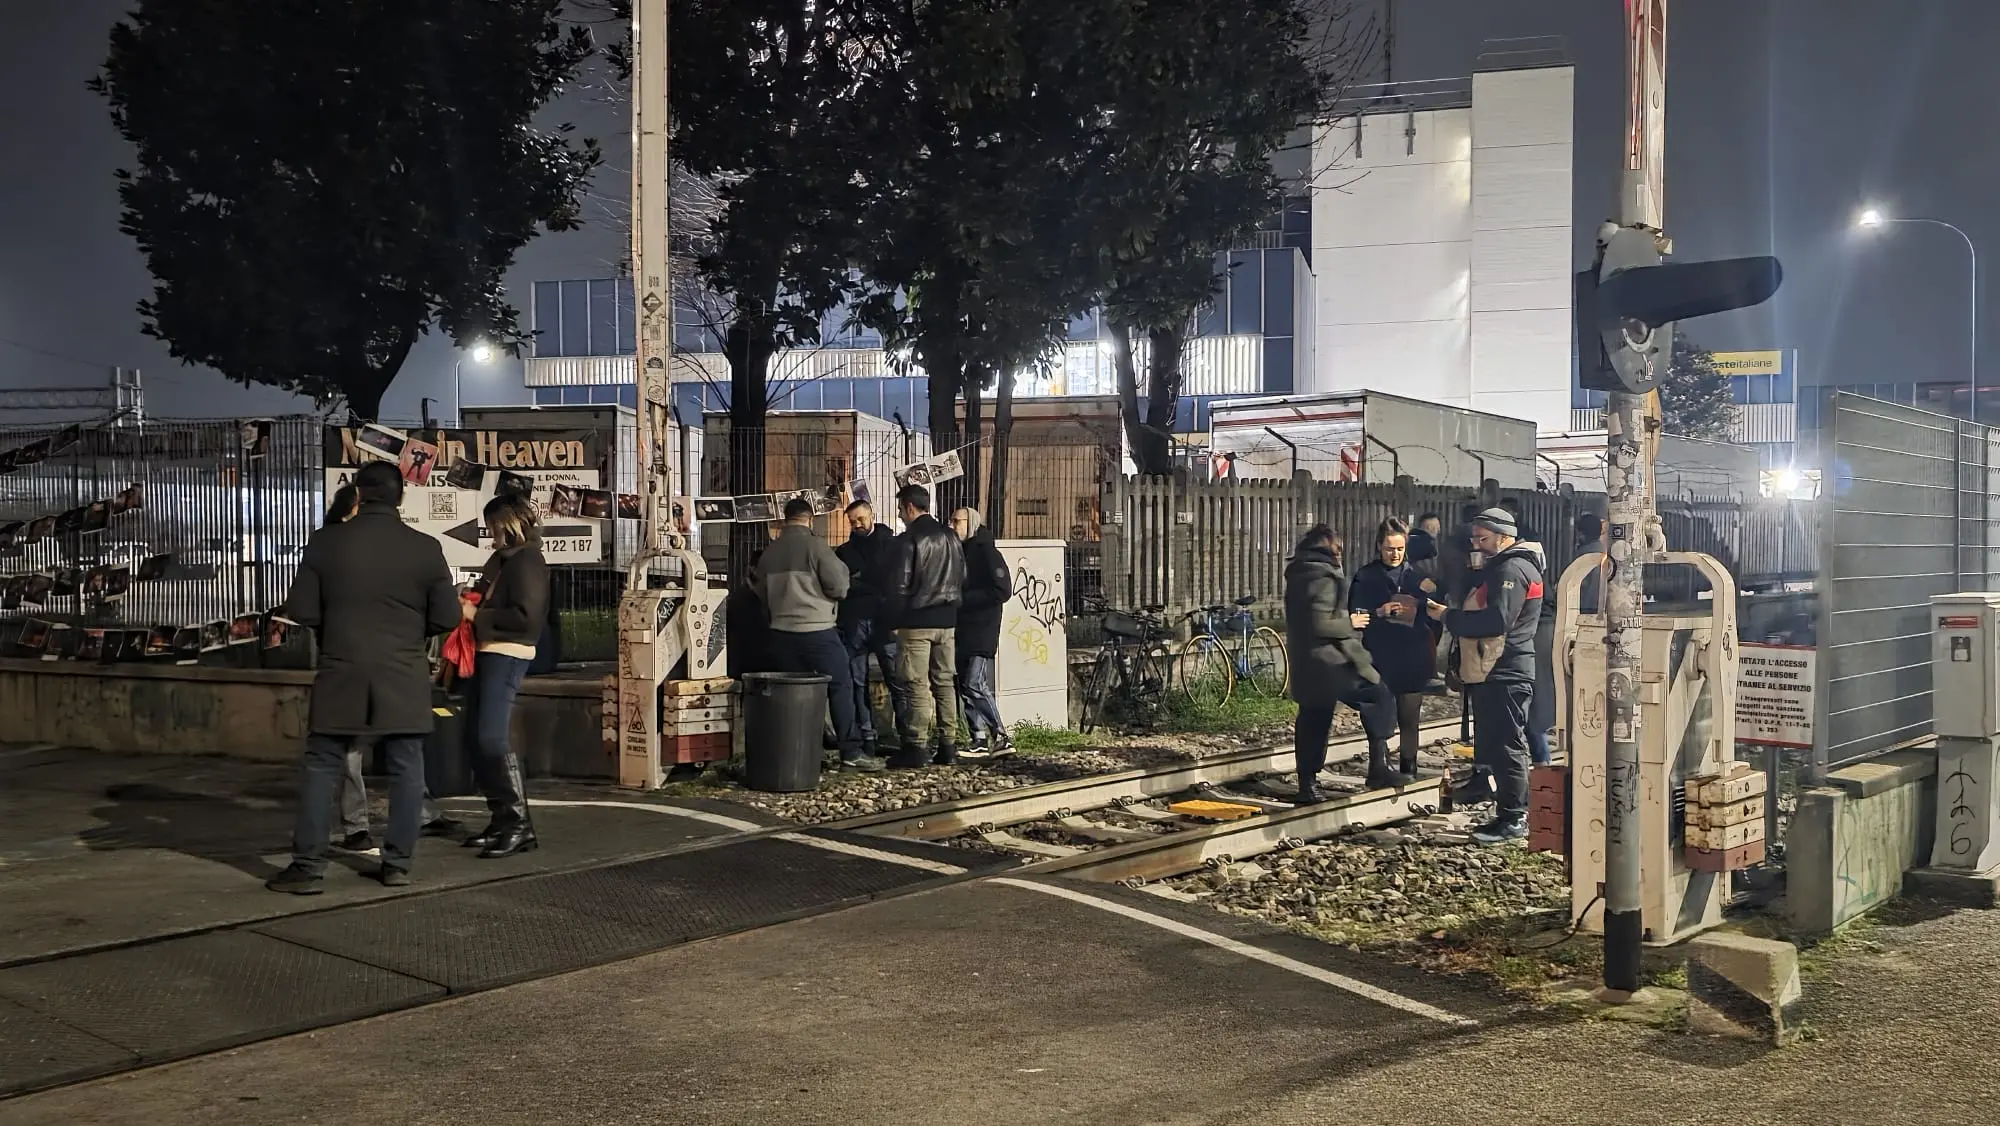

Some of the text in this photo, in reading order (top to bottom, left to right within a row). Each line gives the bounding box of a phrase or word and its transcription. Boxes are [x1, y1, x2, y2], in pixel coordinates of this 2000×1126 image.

[437, 430, 466, 466] in
[477, 430, 584, 467] Heaven
[571, 539, 592, 552] 187
[1768, 659, 1808, 668] L'ACCESSO
[1765, 671, 1799, 679] PERSONE
[1778, 684, 1812, 692] SERVIZIO
